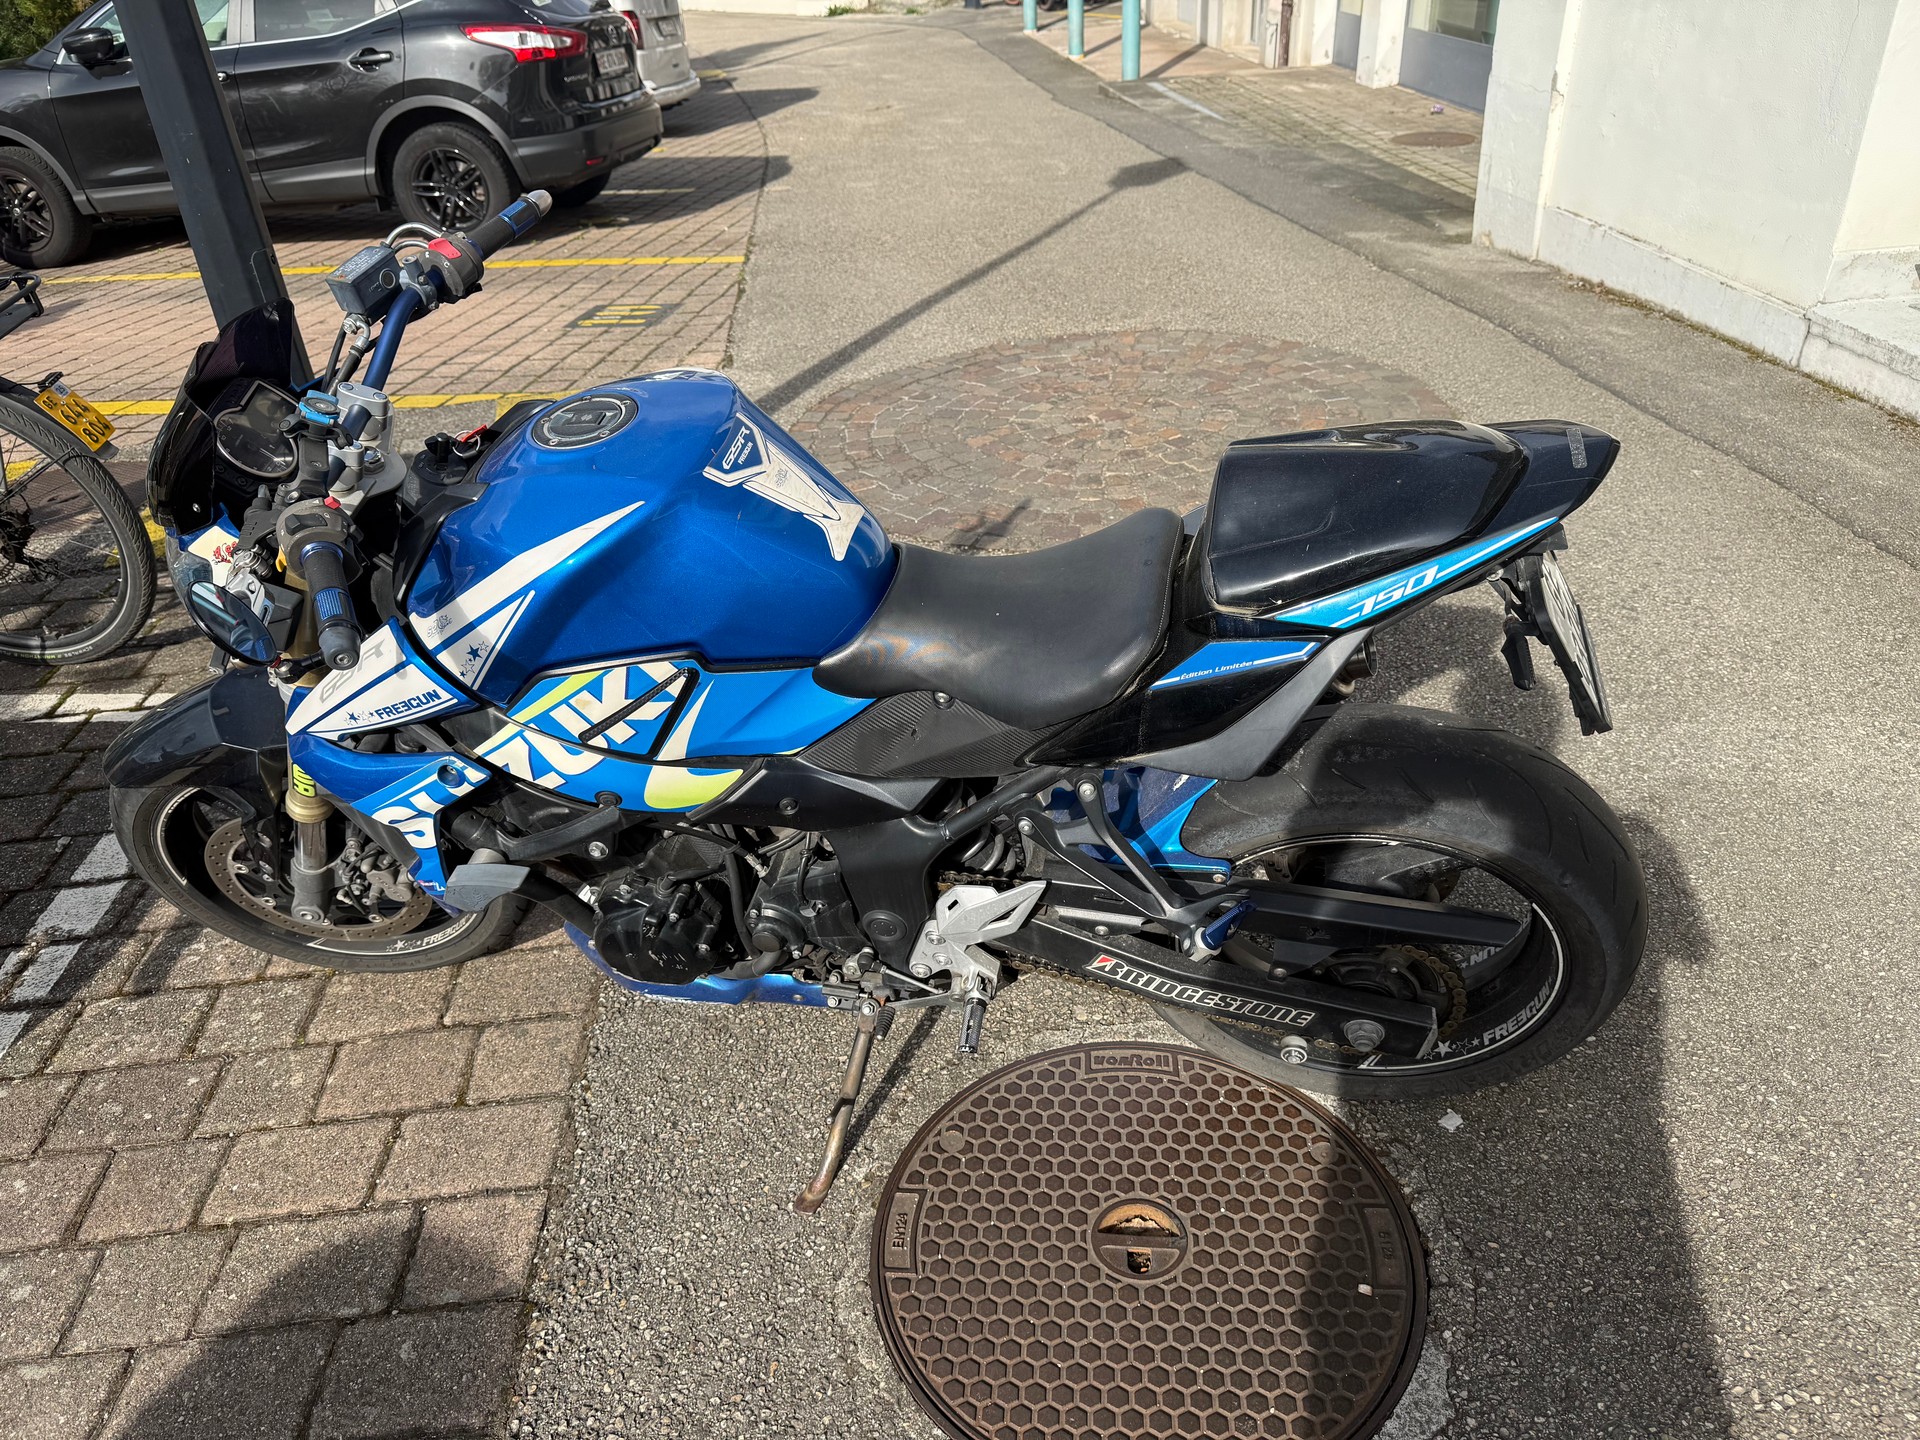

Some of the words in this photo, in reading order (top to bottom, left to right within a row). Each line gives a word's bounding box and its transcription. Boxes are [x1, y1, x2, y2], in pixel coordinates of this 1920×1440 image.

[43, 395, 57, 410] GE
[60, 399, 90, 425] 644
[81, 416, 110, 443] 804
[722, 425, 750, 469] GSR
[1347, 565, 1439, 616] 750
[1215, 661, 1252, 672] Limitée
[374, 689, 442, 719] FREEGUN
[1085, 955, 1315, 1026] BRIDGESTONE
[1482, 982, 1551, 1045] FREEGUN
[892, 1213, 908, 1248] EN124
